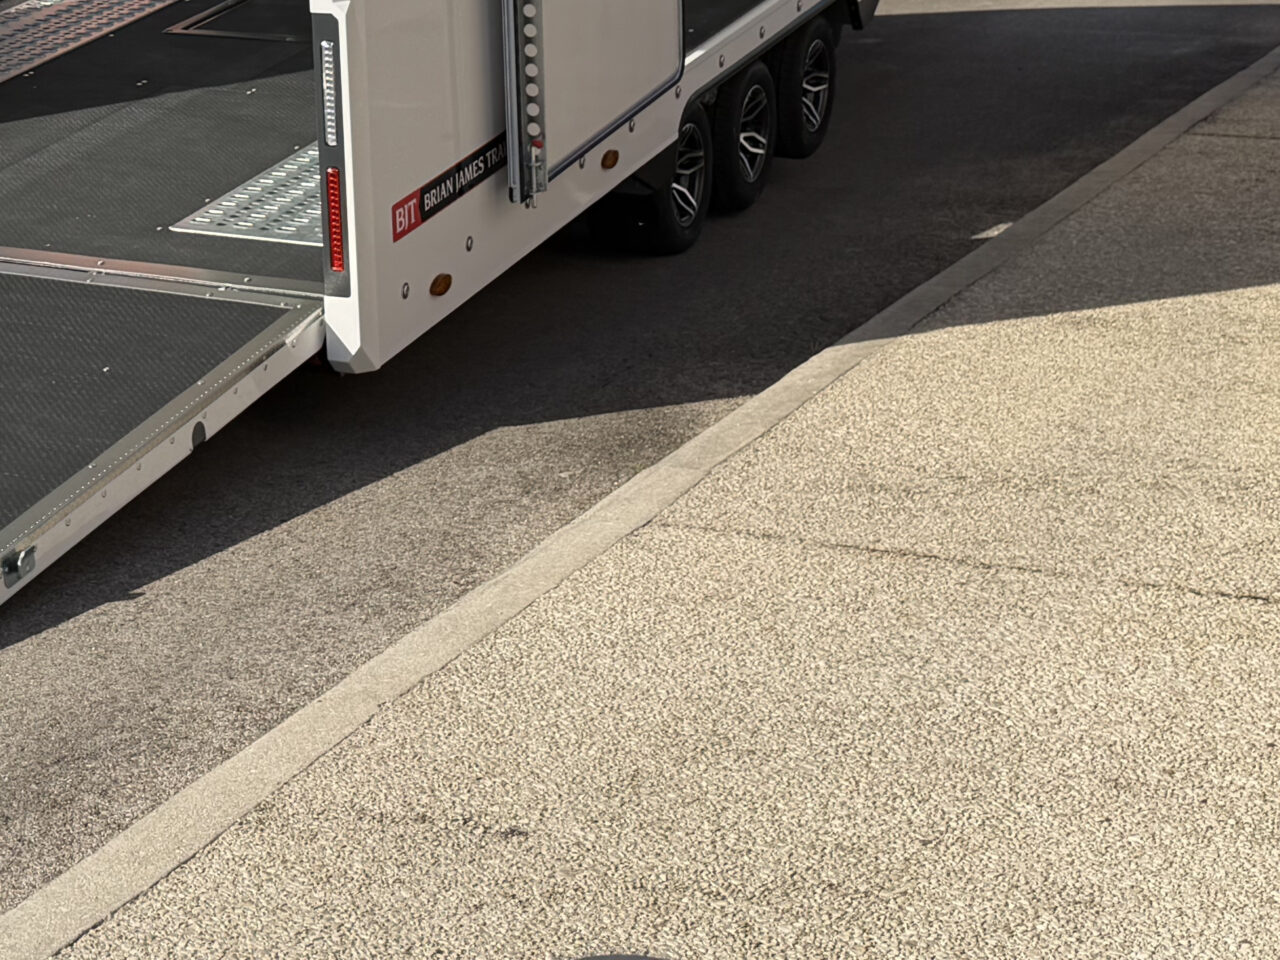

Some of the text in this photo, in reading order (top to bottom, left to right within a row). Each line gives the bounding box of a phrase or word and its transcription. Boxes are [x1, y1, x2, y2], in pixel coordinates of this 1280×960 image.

[394, 141, 506, 234] BJT BRIAN JAMES TRA
